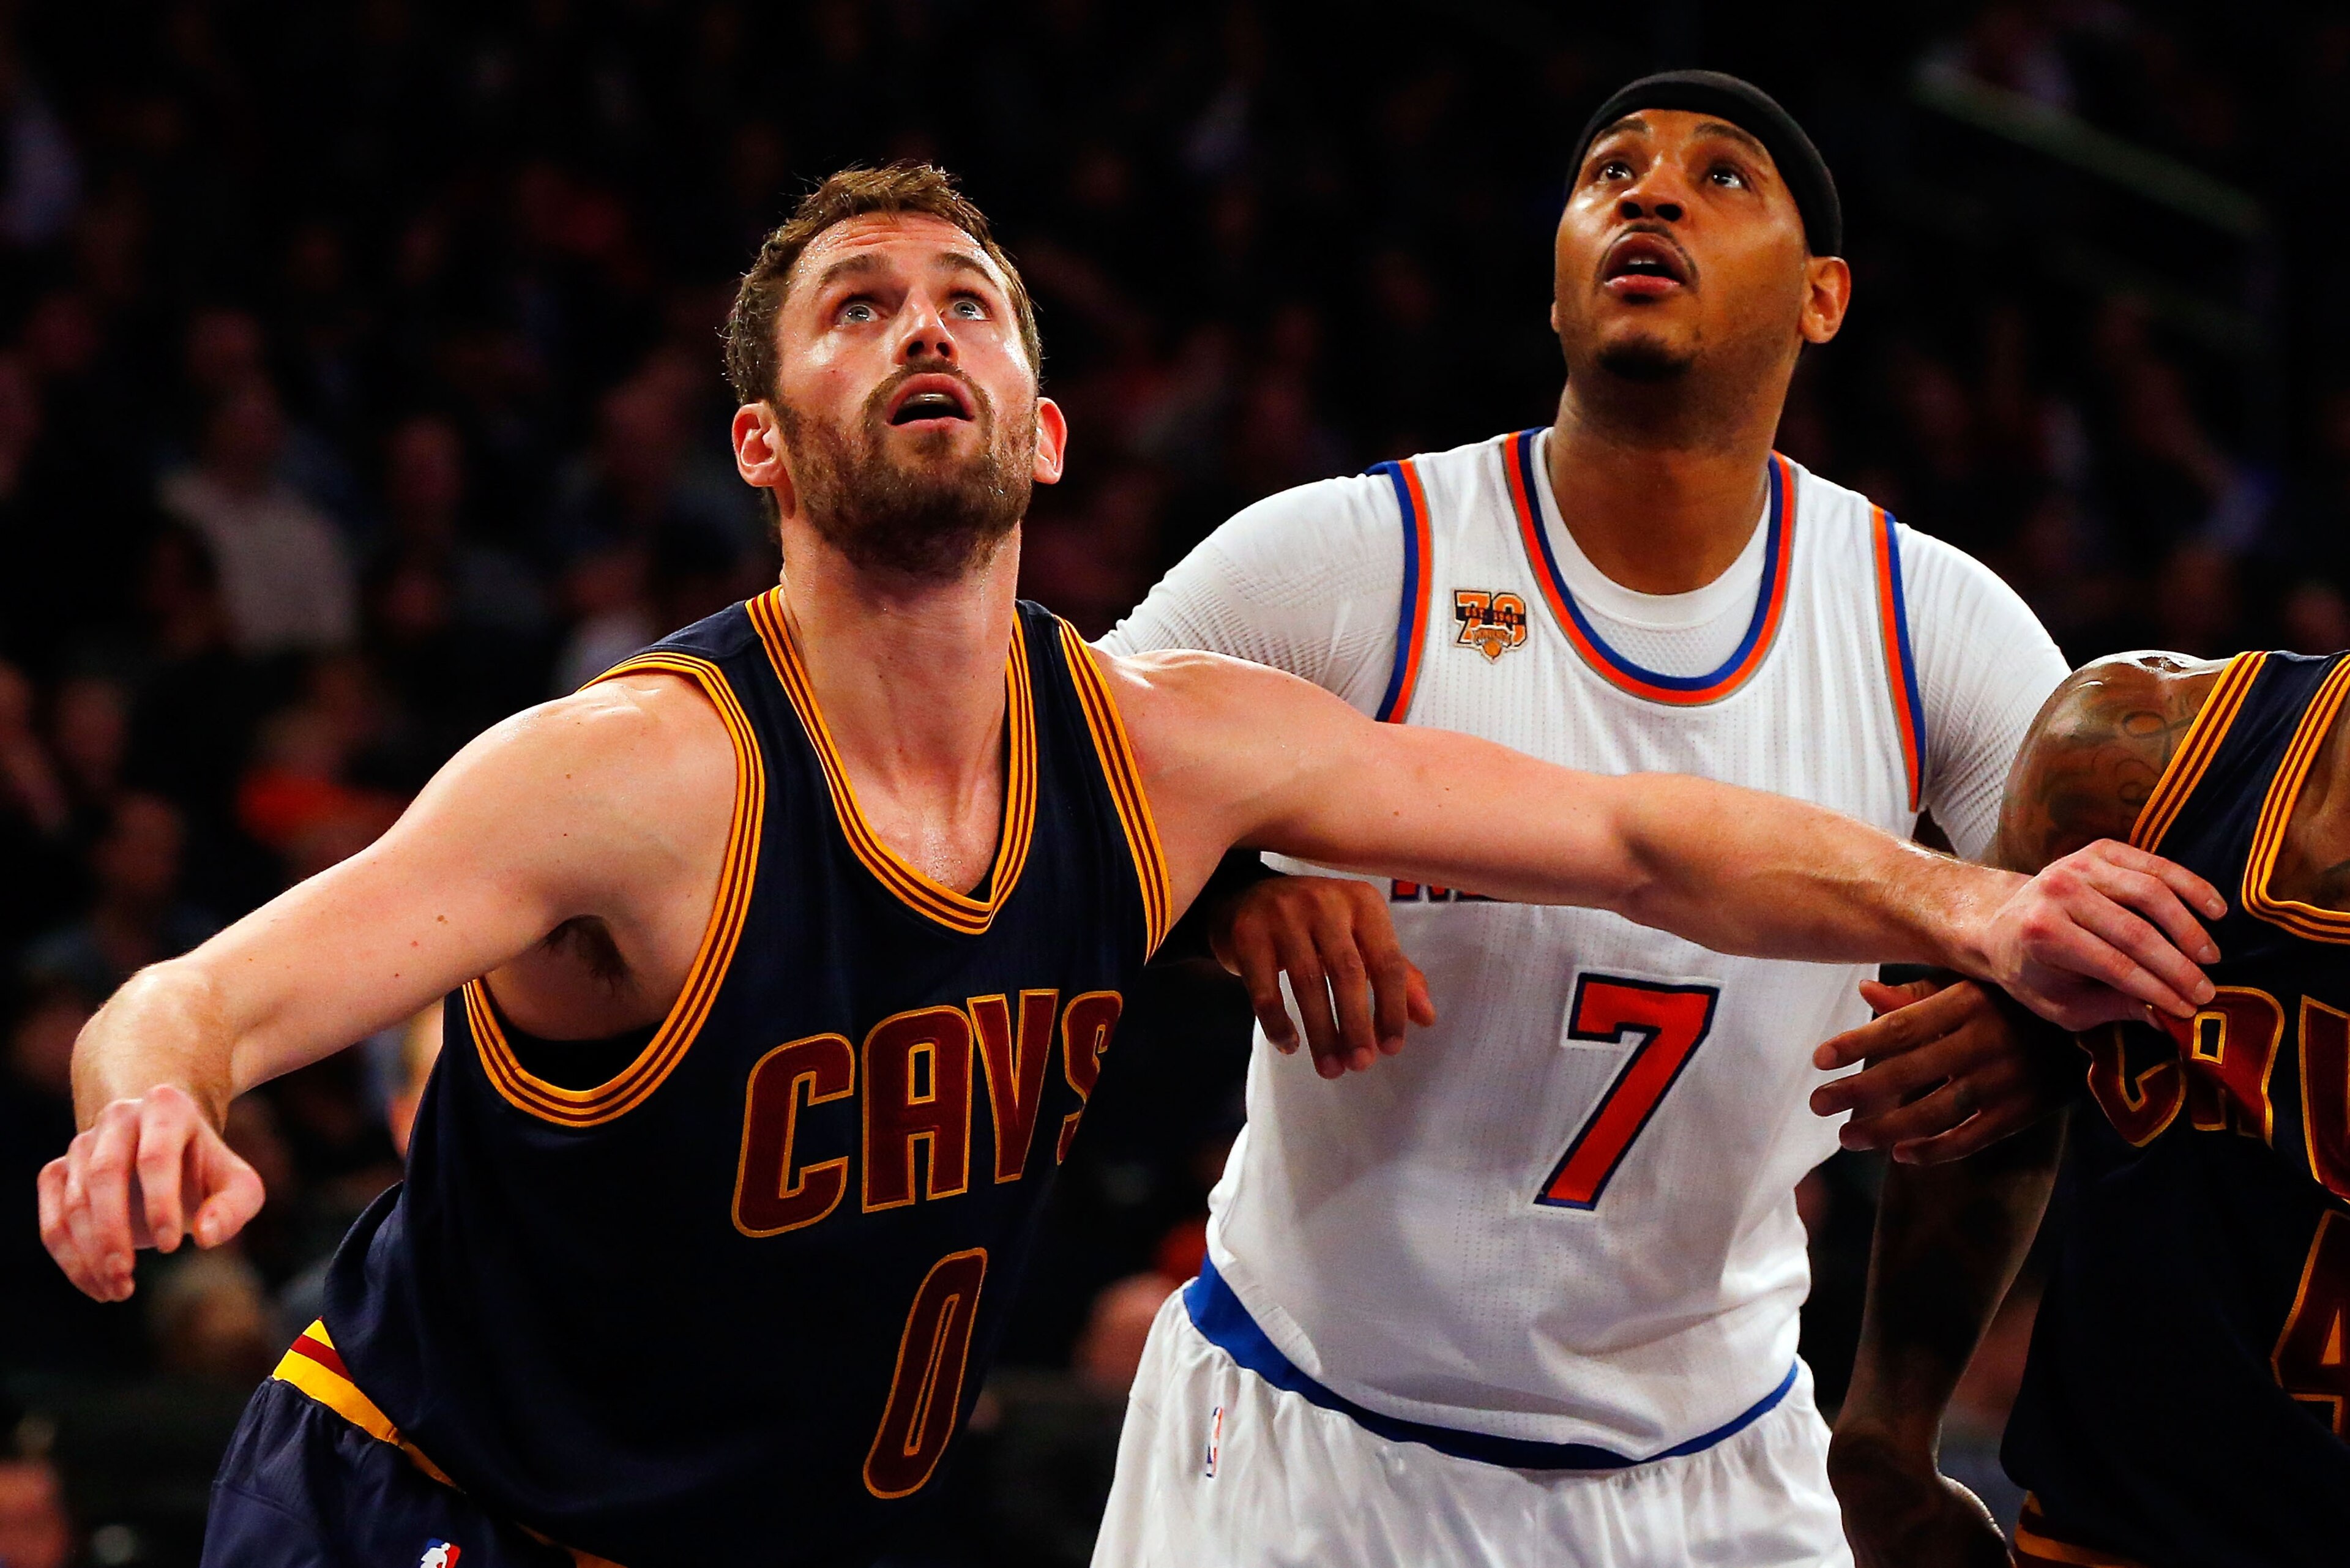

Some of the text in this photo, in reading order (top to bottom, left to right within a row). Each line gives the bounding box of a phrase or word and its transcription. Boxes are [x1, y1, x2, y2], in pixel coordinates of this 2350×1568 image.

[1454, 590, 1527, 646] 70
[731, 988, 1123, 1238] CAVS
[1533, 972, 1720, 1211] 7
[863, 1247, 987, 1499] 0
